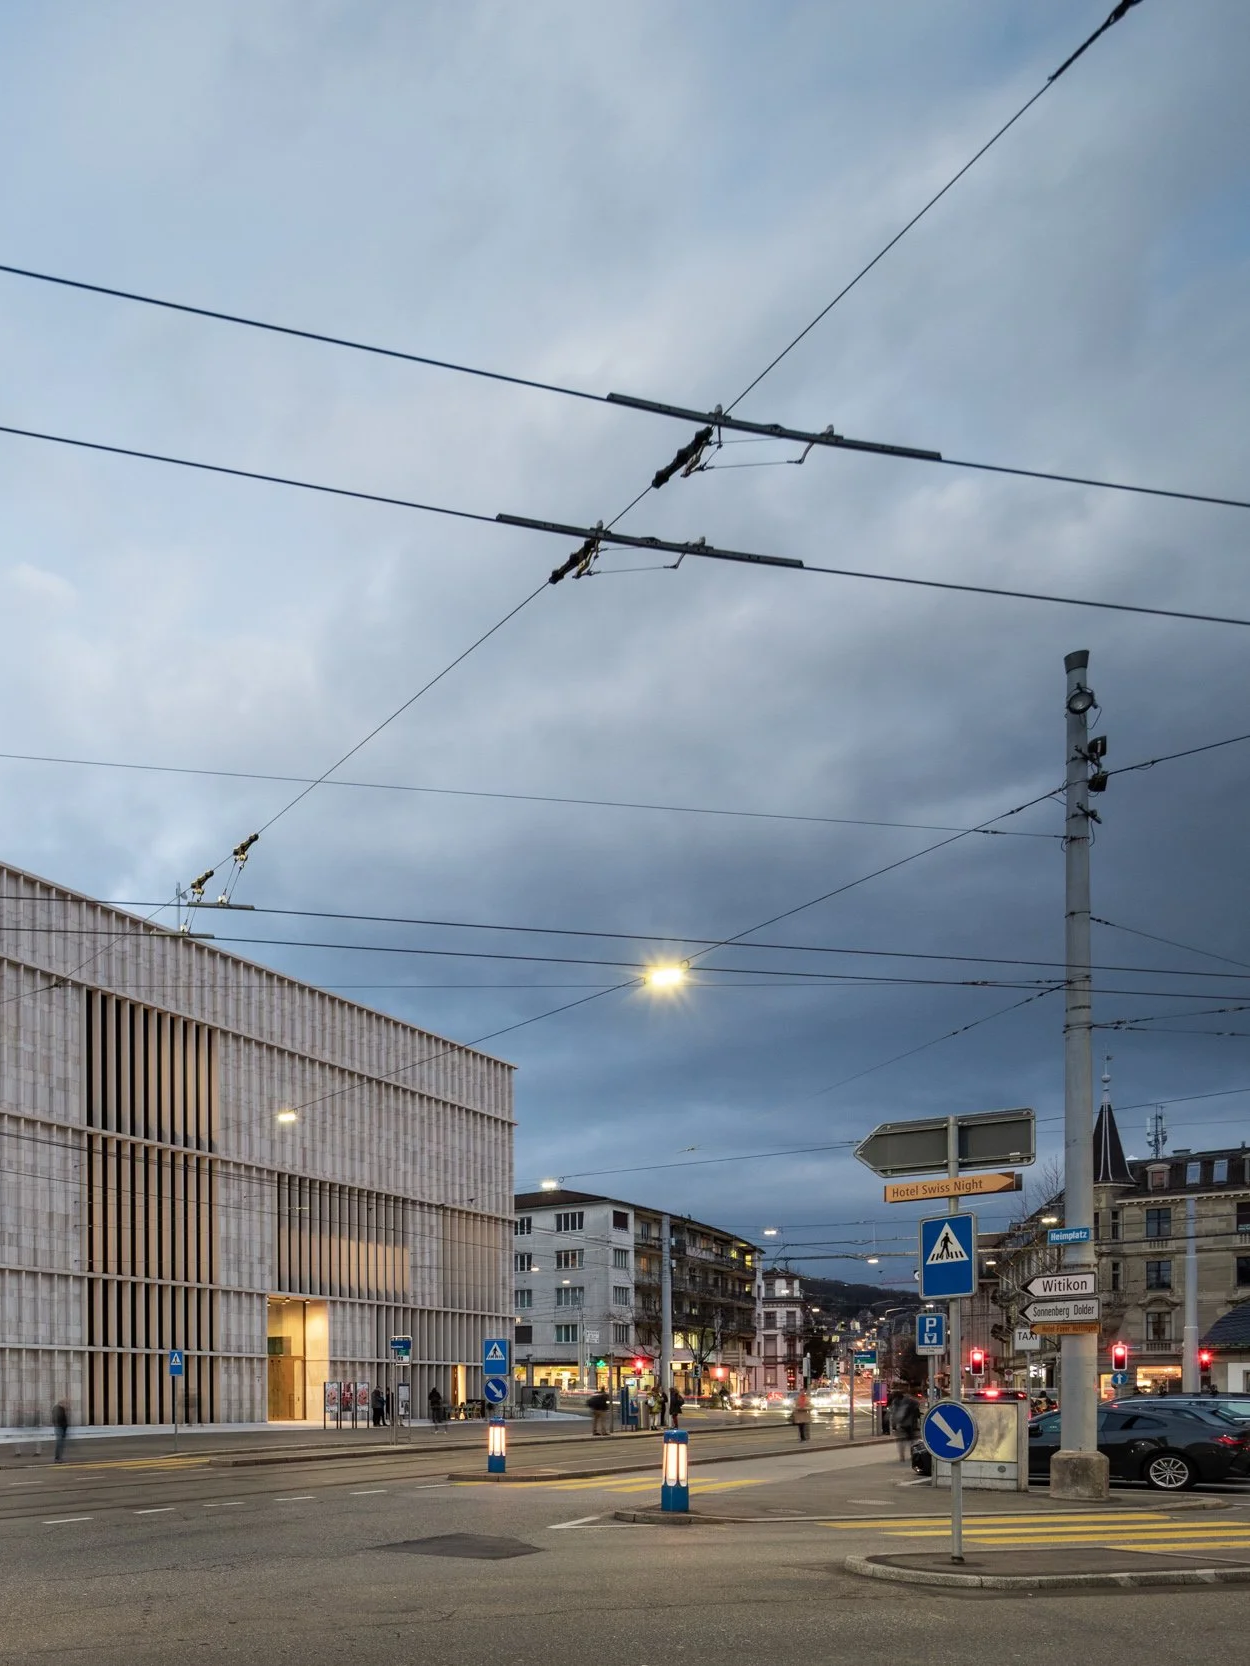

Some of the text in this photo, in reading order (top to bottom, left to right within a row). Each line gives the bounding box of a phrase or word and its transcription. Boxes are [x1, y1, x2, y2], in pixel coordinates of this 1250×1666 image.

[892, 1179, 983, 1198] Hotel Swiss Night
[1050, 1230, 1088, 1241] Heimplatz
[1042, 1277, 1088, 1293] Witikon
[1032, 1304, 1095, 1318] Sonnenberg Dolder
[925, 1317, 937, 1333] P
[1017, 1331, 1038, 1341] TAXI
